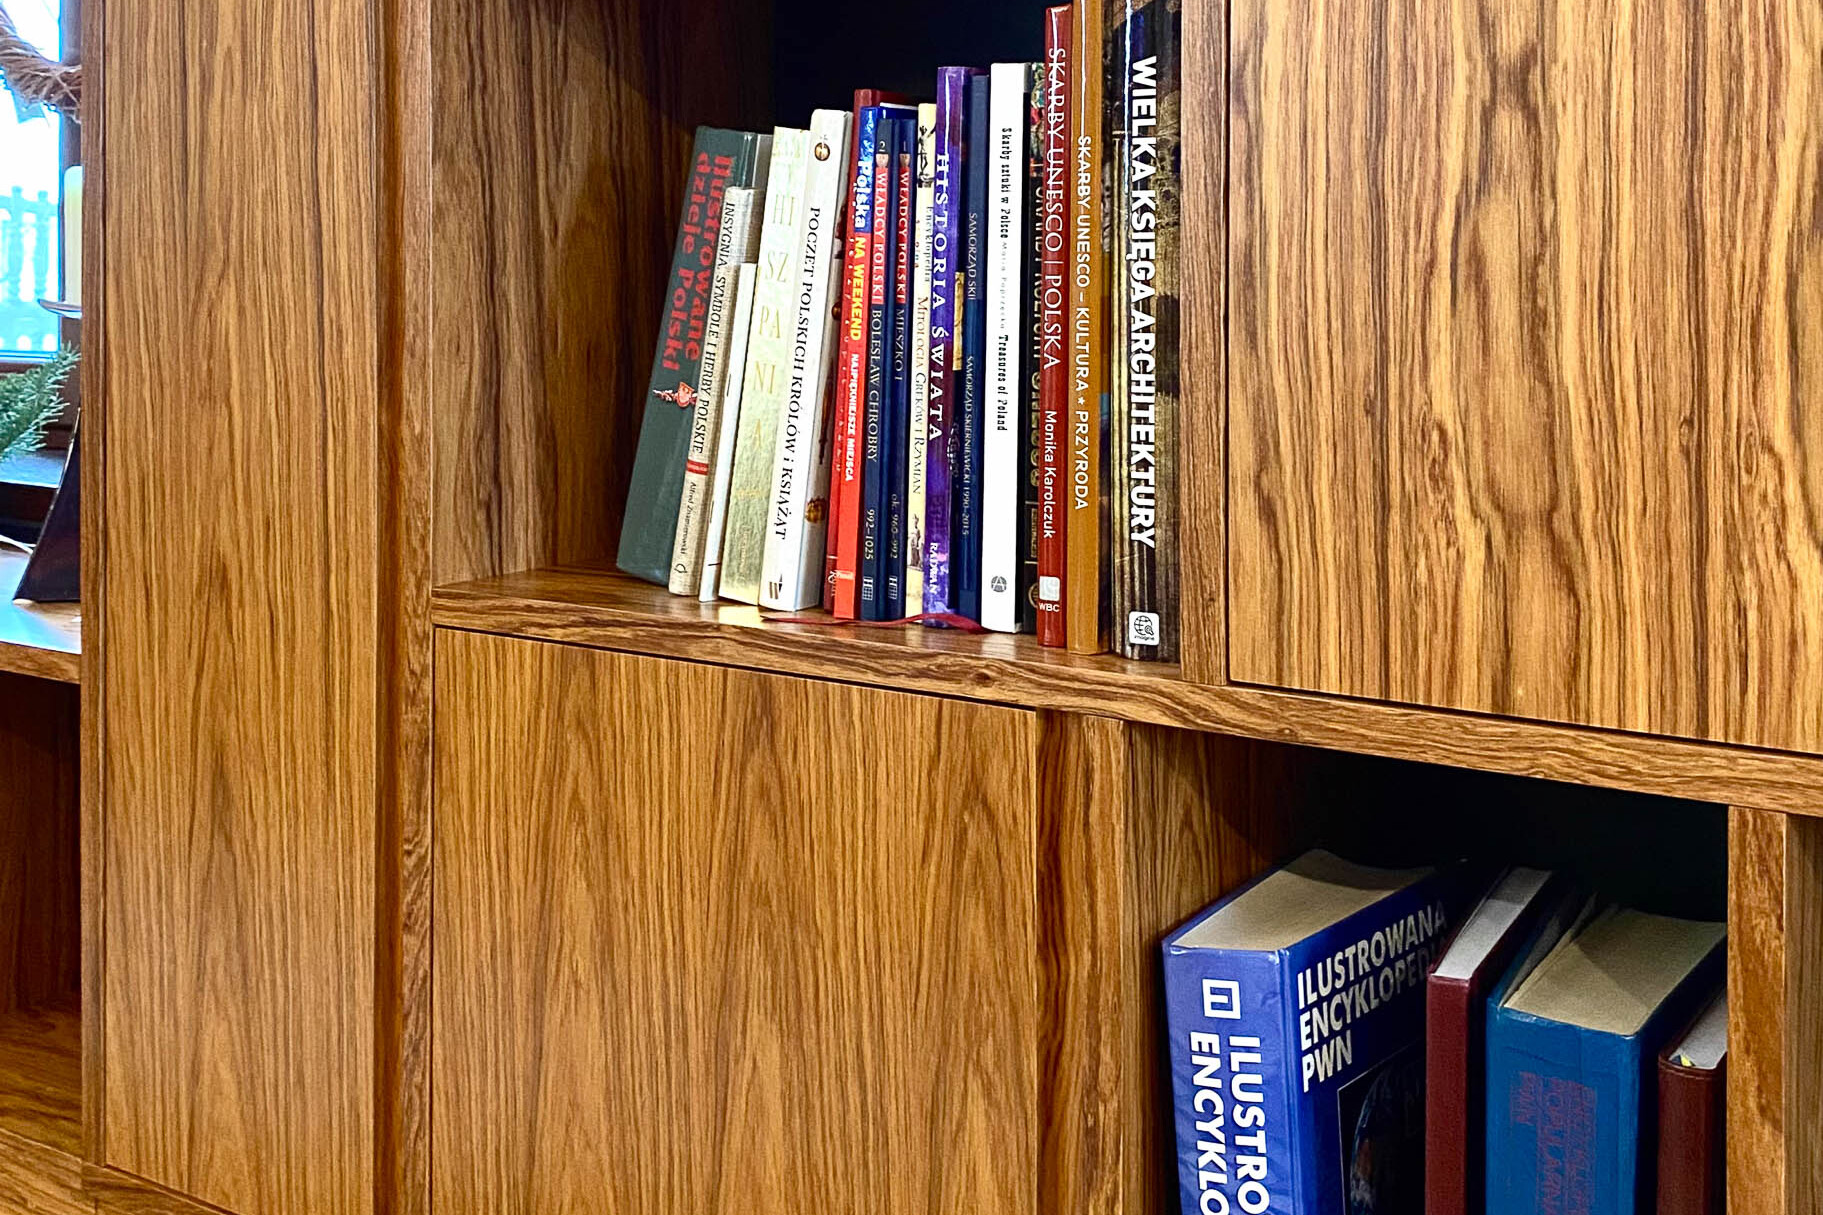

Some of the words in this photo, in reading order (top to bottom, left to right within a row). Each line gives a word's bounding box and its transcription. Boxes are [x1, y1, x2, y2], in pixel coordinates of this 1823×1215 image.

[1046, 47, 1066, 140] SKARBY
[1131, 55, 1157, 183] WIELKA
[1000, 127, 1012, 160] Skarby
[1001, 164, 1011, 193] sztuki
[1077, 135, 1091, 209] SKARBY
[682, 152, 712, 254] dzieje
[854, 160, 874, 229] Polska
[873, 172, 888, 234] WŁADCY
[898, 172, 909, 236] WŁADCY
[1000, 208, 1012, 239] Polsce
[1044, 147, 1064, 252] UNESCO
[685, 155, 734, 361] Ilustrowane
[804, 207, 821, 278] POCZET
[854, 237, 867, 259] NA
[932, 153, 950, 310] HISTORIA
[967, 213, 977, 278] SAMORZĄD
[1076, 214, 1091, 288] UNESCO
[1125, 190, 1156, 303] KSIĘGA
[707, 274, 726, 339] SYMBOLE
[850, 263, 866, 341] WEEKEND
[872, 243, 885, 304] POLSKI
[897, 243, 908, 303] POLSKI
[662, 267, 695, 371] Polski
[793, 282, 813, 370] POLSKICH
[869, 310, 882, 387] BOLESŁAW
[894, 309, 905, 372] MIESZKO
[1043, 275, 1062, 370] POLSKA
[1075, 307, 1090, 391] KULTURA
[699, 351, 716, 396] HERBY
[847, 353, 860, 435] NAJPIĘKNIEJSZE
[929, 325, 949, 441] ŚWIATA
[998, 335, 1009, 381] Treasures
[998, 386, 1009, 395] of
[692, 398, 709, 454] POLSKIE
[783, 377, 803, 454] KRÓLÓW
[867, 390, 880, 462] CHROBRY
[997, 399, 1008, 431] Poland
[1044, 410, 1057, 463] Monika
[1130, 309, 1156, 549] ARCHITEKTURY
[845, 438, 857, 482] MIEJSCA
[1074, 411, 1089, 510] PRZYRODA
[773, 467, 793, 540] KSIĄŻĄT
[1043, 466, 1057, 539] Karolczuk
[1038, 602, 1060, 613] WBC
[1297, 900, 1448, 1010] ILUSTROWANA
[1302, 1029, 1353, 1093] PWN
